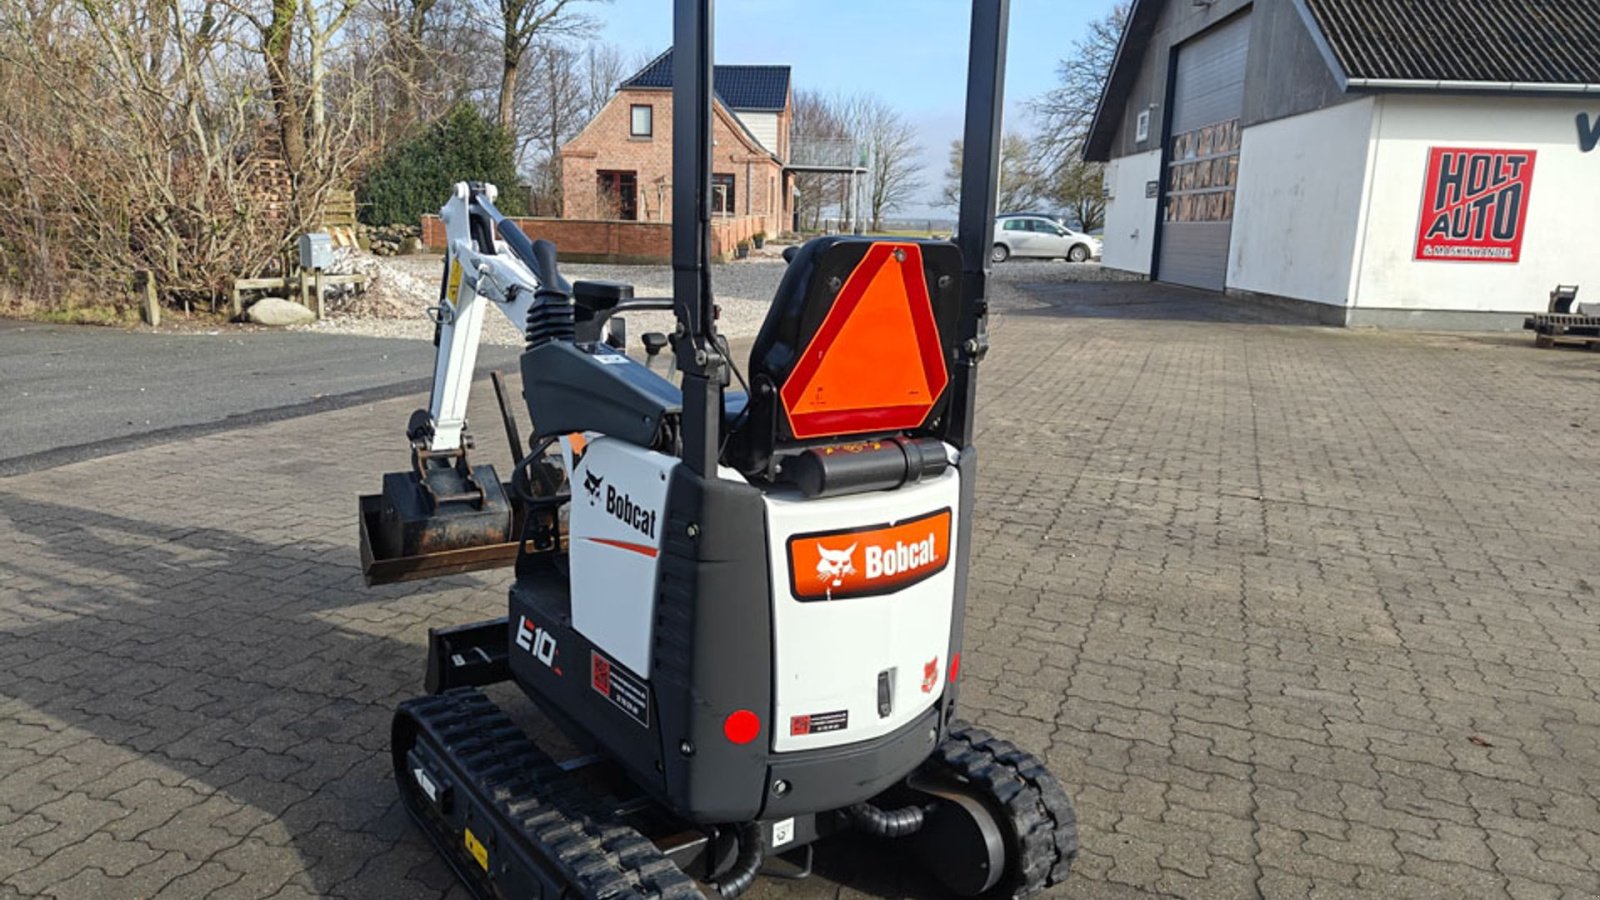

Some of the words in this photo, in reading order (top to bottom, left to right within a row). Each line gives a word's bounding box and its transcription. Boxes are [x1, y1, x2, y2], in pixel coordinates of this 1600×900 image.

[1433, 153, 1528, 213] HOLT
[1424, 181, 1523, 241] AUTO
[606, 484, 656, 539] Bobcat
[865, 532, 935, 579] Bobcat
[516, 614, 557, 667] E10
